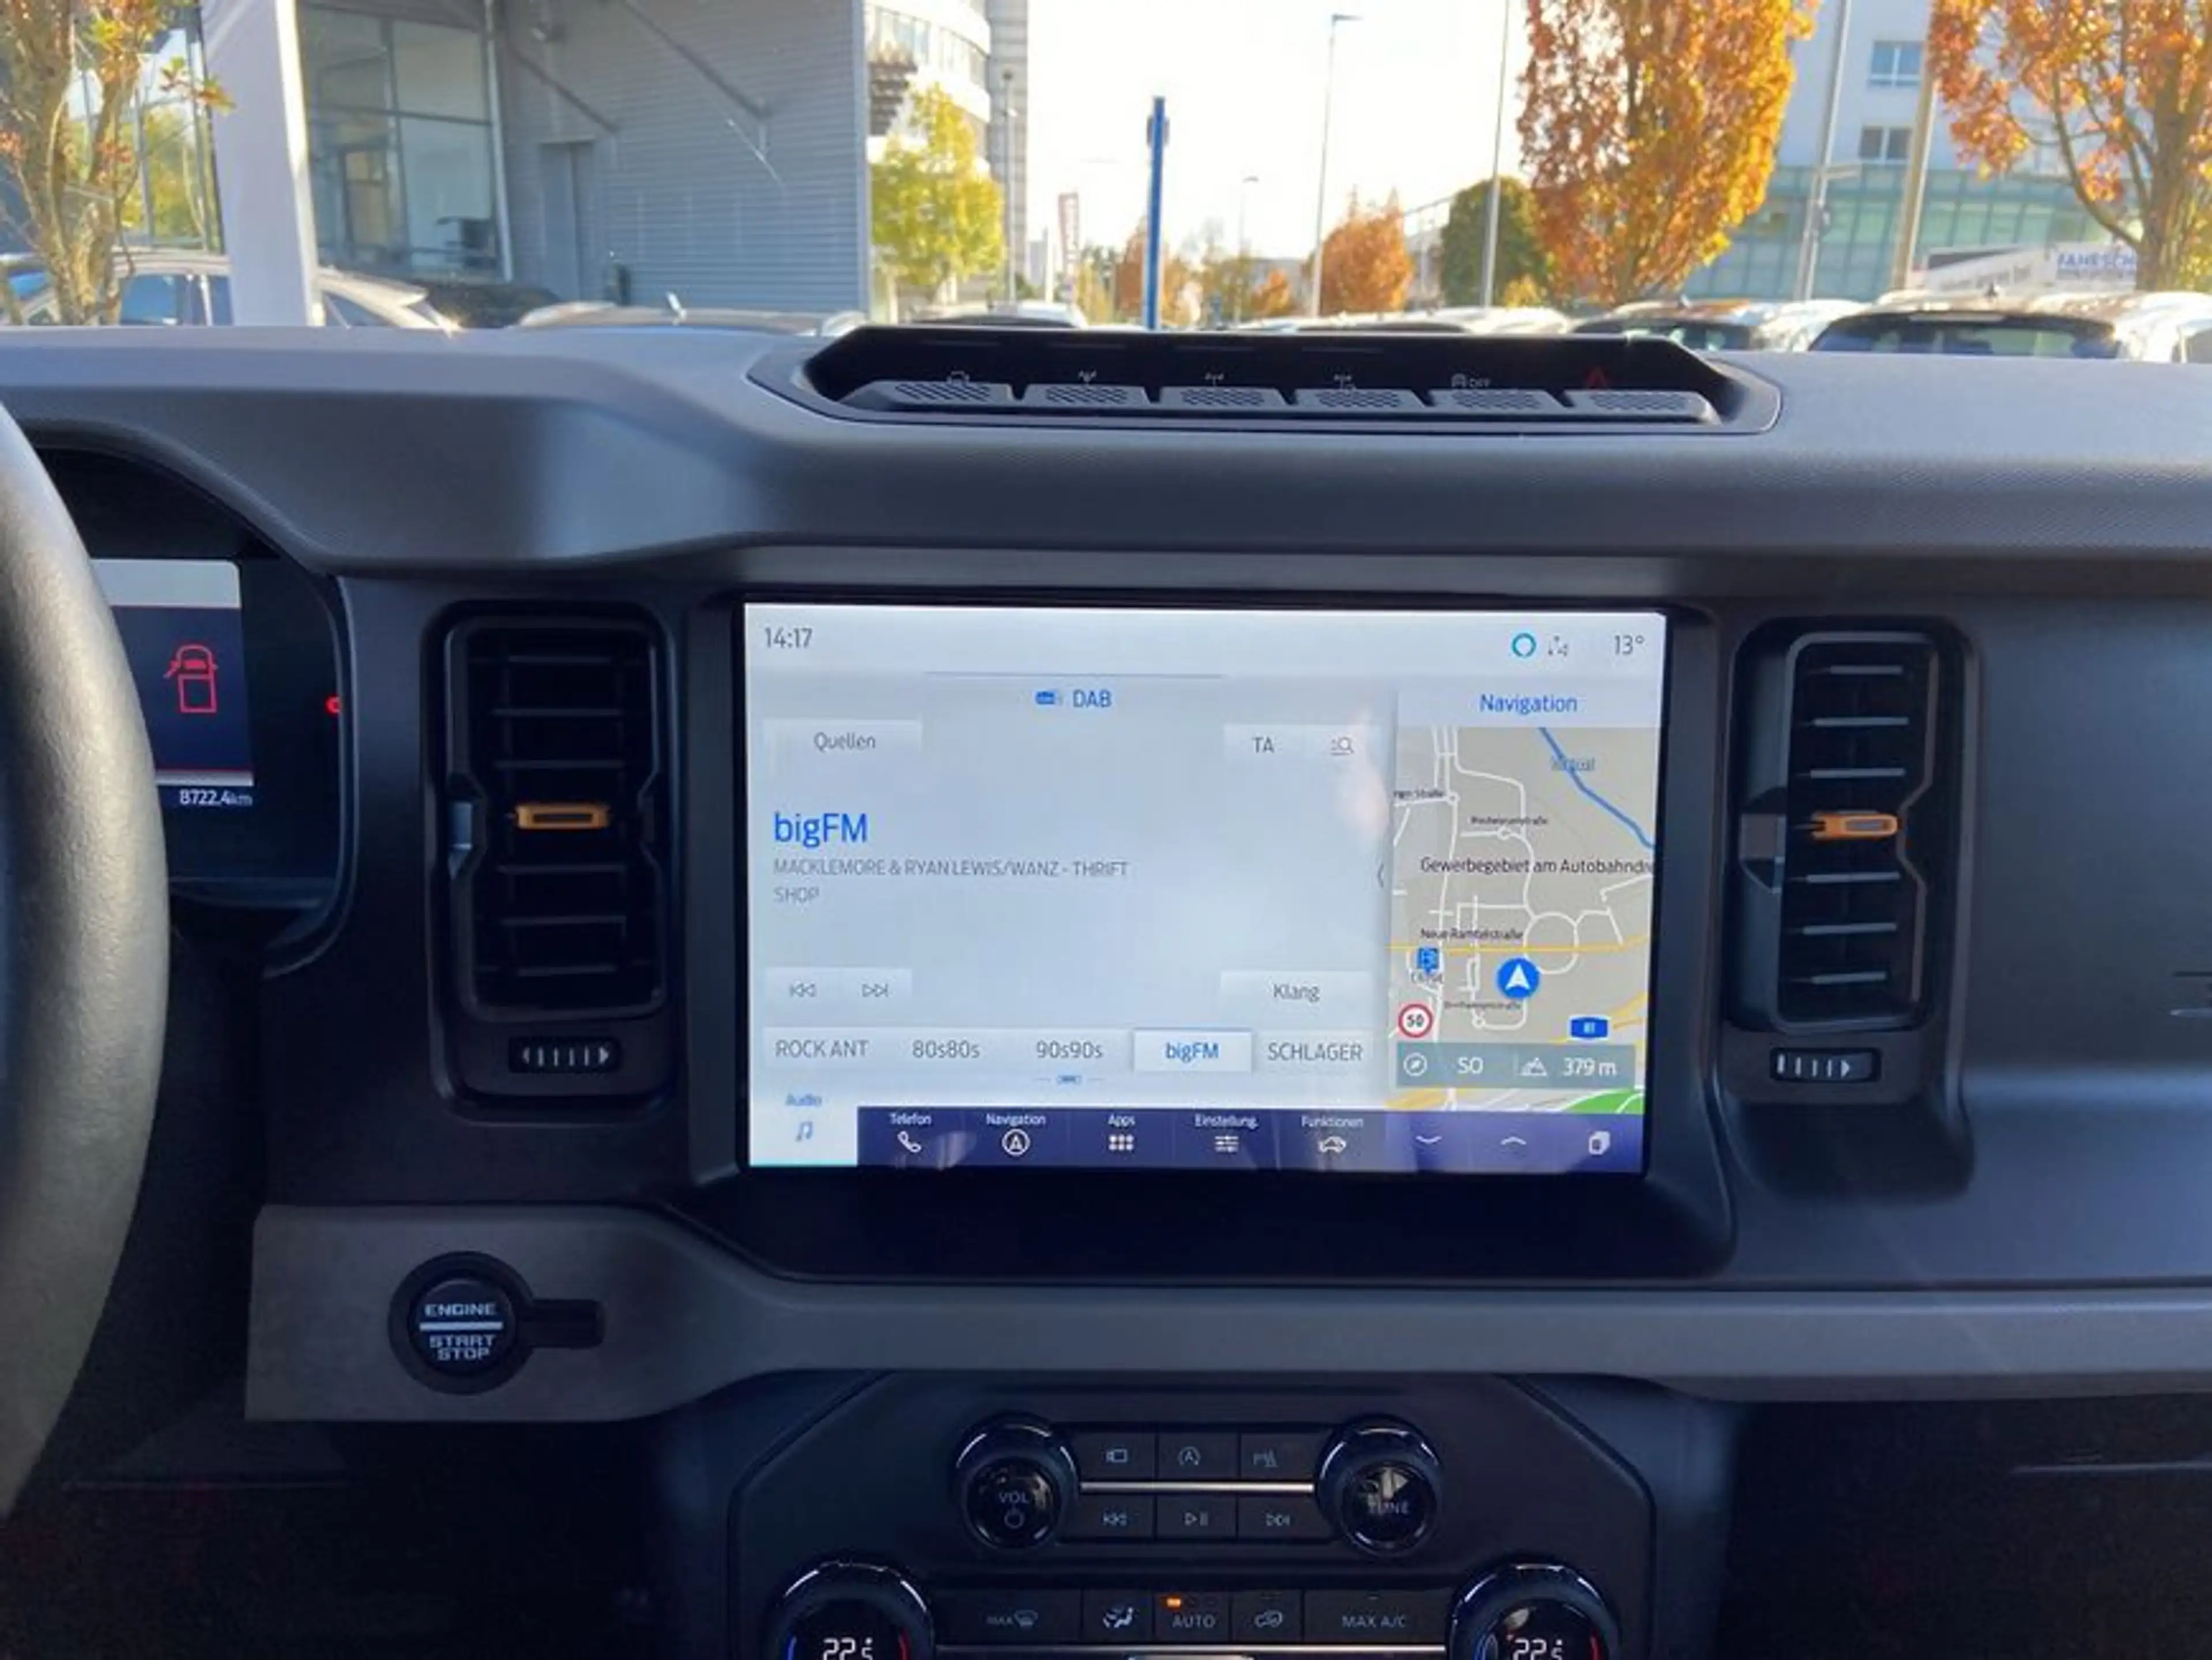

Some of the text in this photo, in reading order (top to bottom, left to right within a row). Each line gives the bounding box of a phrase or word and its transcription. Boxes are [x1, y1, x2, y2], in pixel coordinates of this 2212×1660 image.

[764, 626, 813, 650] 14:17
[1614, 635, 1645, 655] 13°
[1072, 689, 1112, 708] DAB
[1479, 693, 1578, 715] Navigation
[813, 731, 876, 752] Quellen
[1253, 737, 1275, 754] TA
[773, 813, 868, 847] bigFM
[774, 859, 886, 876] MACKLEMORE
[888, 859, 901, 876] &
[905, 859, 949, 876] RYAN
[1073, 861, 1128, 877] THRIFT
[1420, 857, 1529, 876] Gewerbegebiet
[1533, 860, 1557, 873] am
[774, 886, 819, 903] SHOP
[1272, 983, 1320, 1003] Klang
[1407, 1013, 1425, 1027] 50
[775, 1040, 869, 1058] ROCK ANT
[912, 1040, 980, 1059] 80s80s
[1037, 1040, 1103, 1059] 90s90s
[1166, 1042, 1220, 1062] bigFM
[1563, 1058, 1616, 1077] 379 m
[786, 1093, 822, 1106] Audio
[889, 1112, 932, 1125] Telefon
[986, 1113, 1046, 1127] Navigation
[1108, 1114, 1135, 1128] Apps
[1302, 1116, 1364, 1128] Funktionen
[425, 1303, 496, 1316] ENGINE
[430, 1334, 496, 1348] START
[438, 1348, 489, 1361] STOP
[1000, 1492, 1030, 1504] VOL
[1368, 1498, 1409, 1514] TUNE
[1173, 1614, 1215, 1628] AUTO
[1342, 1614, 1405, 1628] MAX A/C
